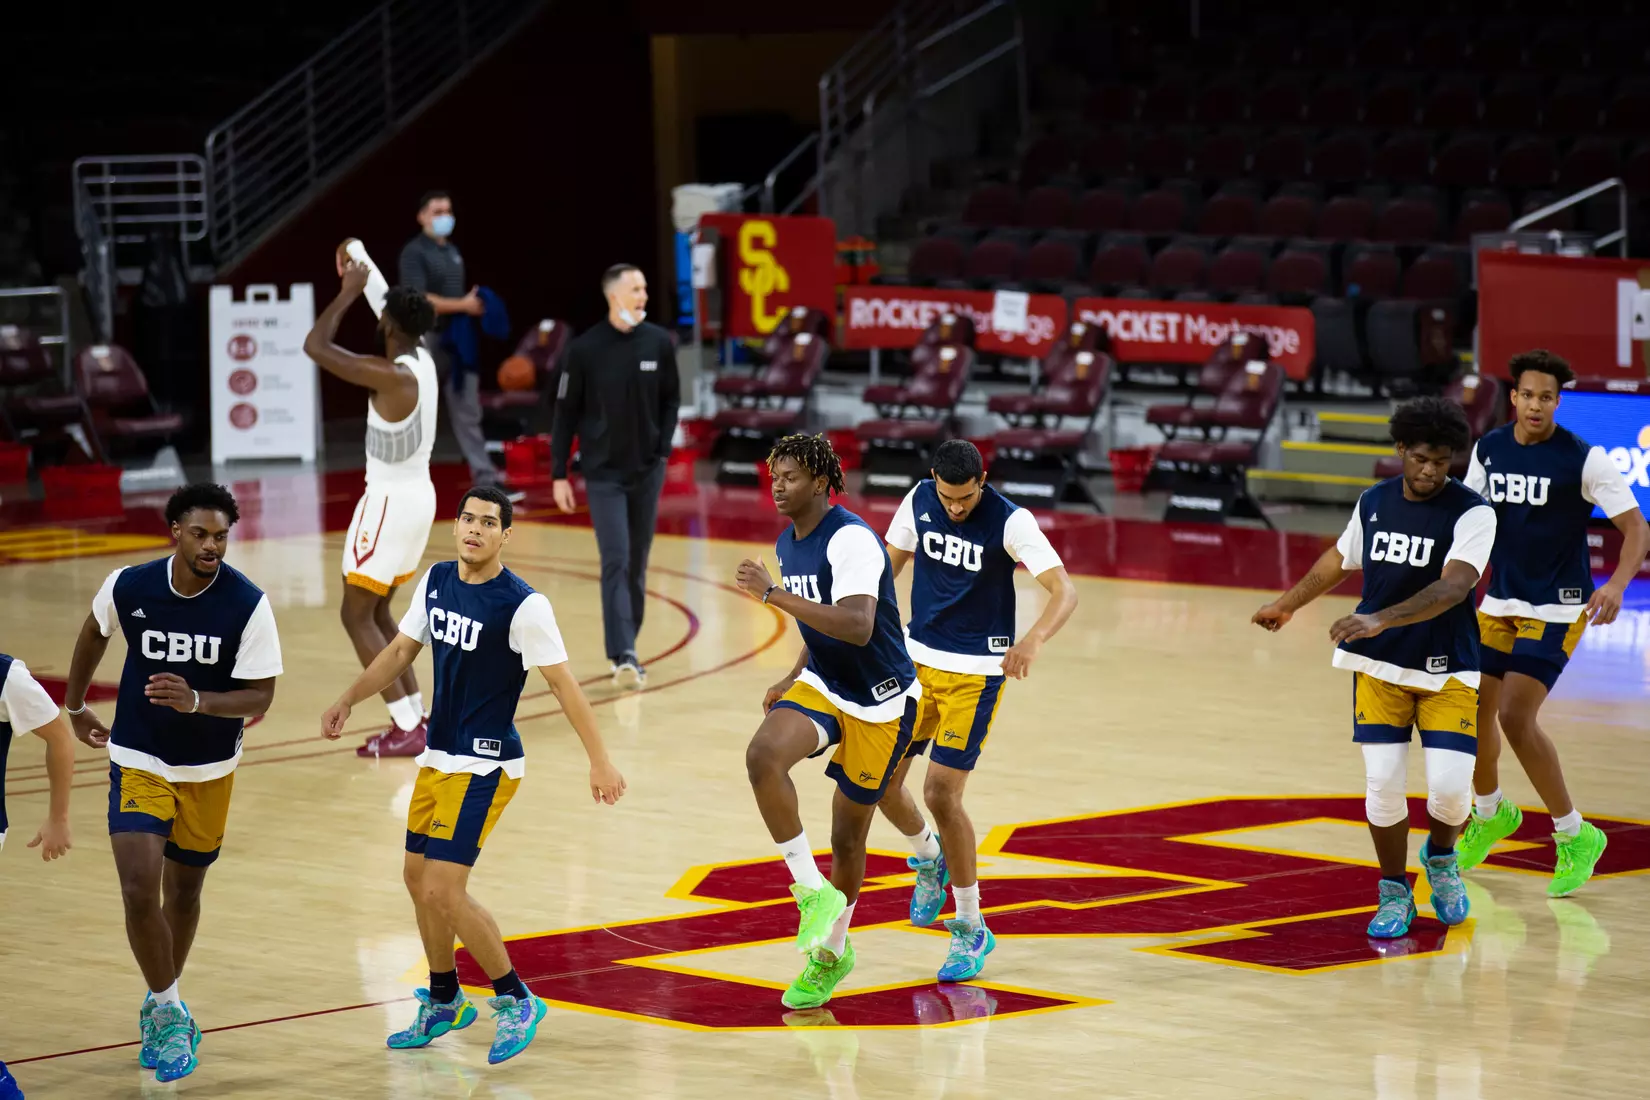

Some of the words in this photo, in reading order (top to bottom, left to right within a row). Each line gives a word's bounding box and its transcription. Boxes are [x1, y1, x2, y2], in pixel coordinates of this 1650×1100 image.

[1489, 472, 1551, 506] CBU
[923, 531, 983, 572] CBU
[1370, 531, 1435, 567] CBU
[429, 606, 484, 651] CBU
[141, 629, 222, 665] CBU
